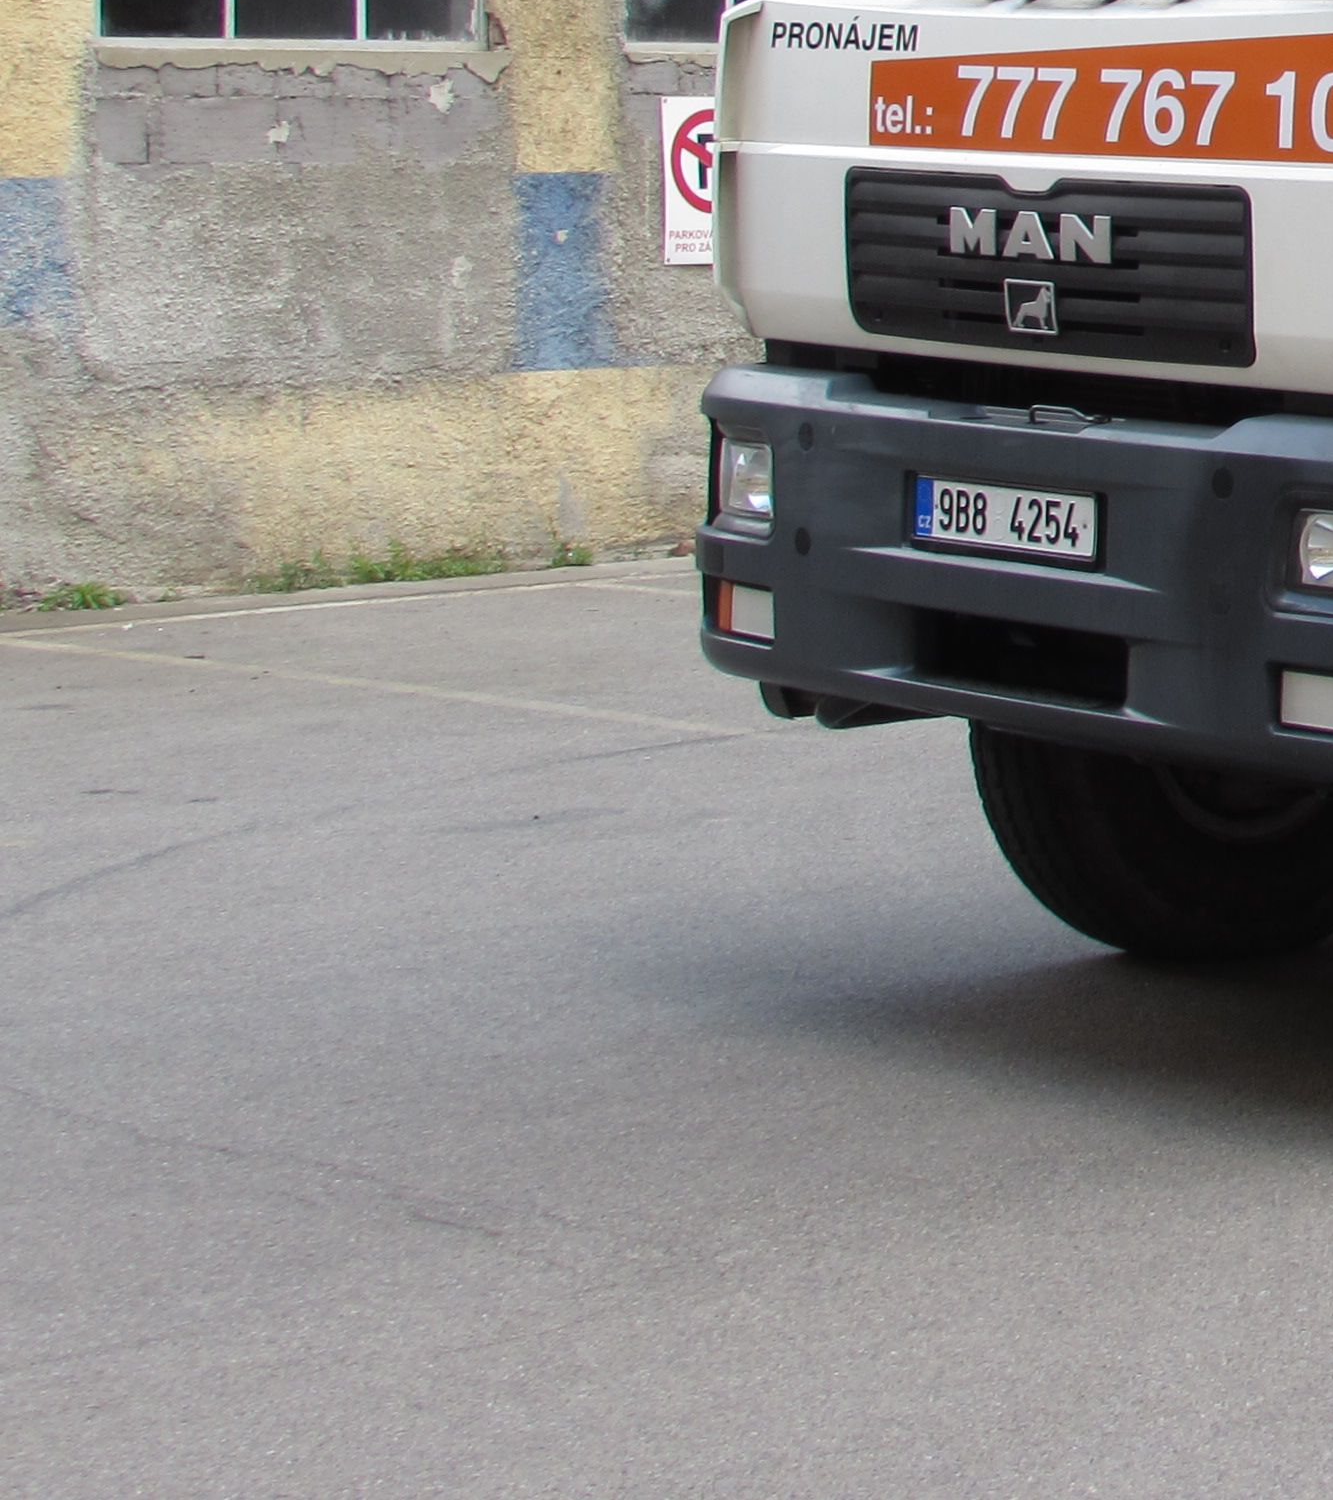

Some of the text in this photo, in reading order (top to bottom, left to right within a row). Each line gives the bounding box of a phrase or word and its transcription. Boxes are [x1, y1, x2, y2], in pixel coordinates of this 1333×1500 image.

[770, 15, 920, 53] PRONÁJEM
[873, 95, 933, 137] tel.:
[956, 64, 1079, 142] 777
[1099, 68, 1237, 148] 767
[669, 230, 713, 240] PARKOV
[948, 205, 1113, 266] MAN
[917, 514, 932, 529] CZ
[939, 486, 1080, 548] 9B8 4254
